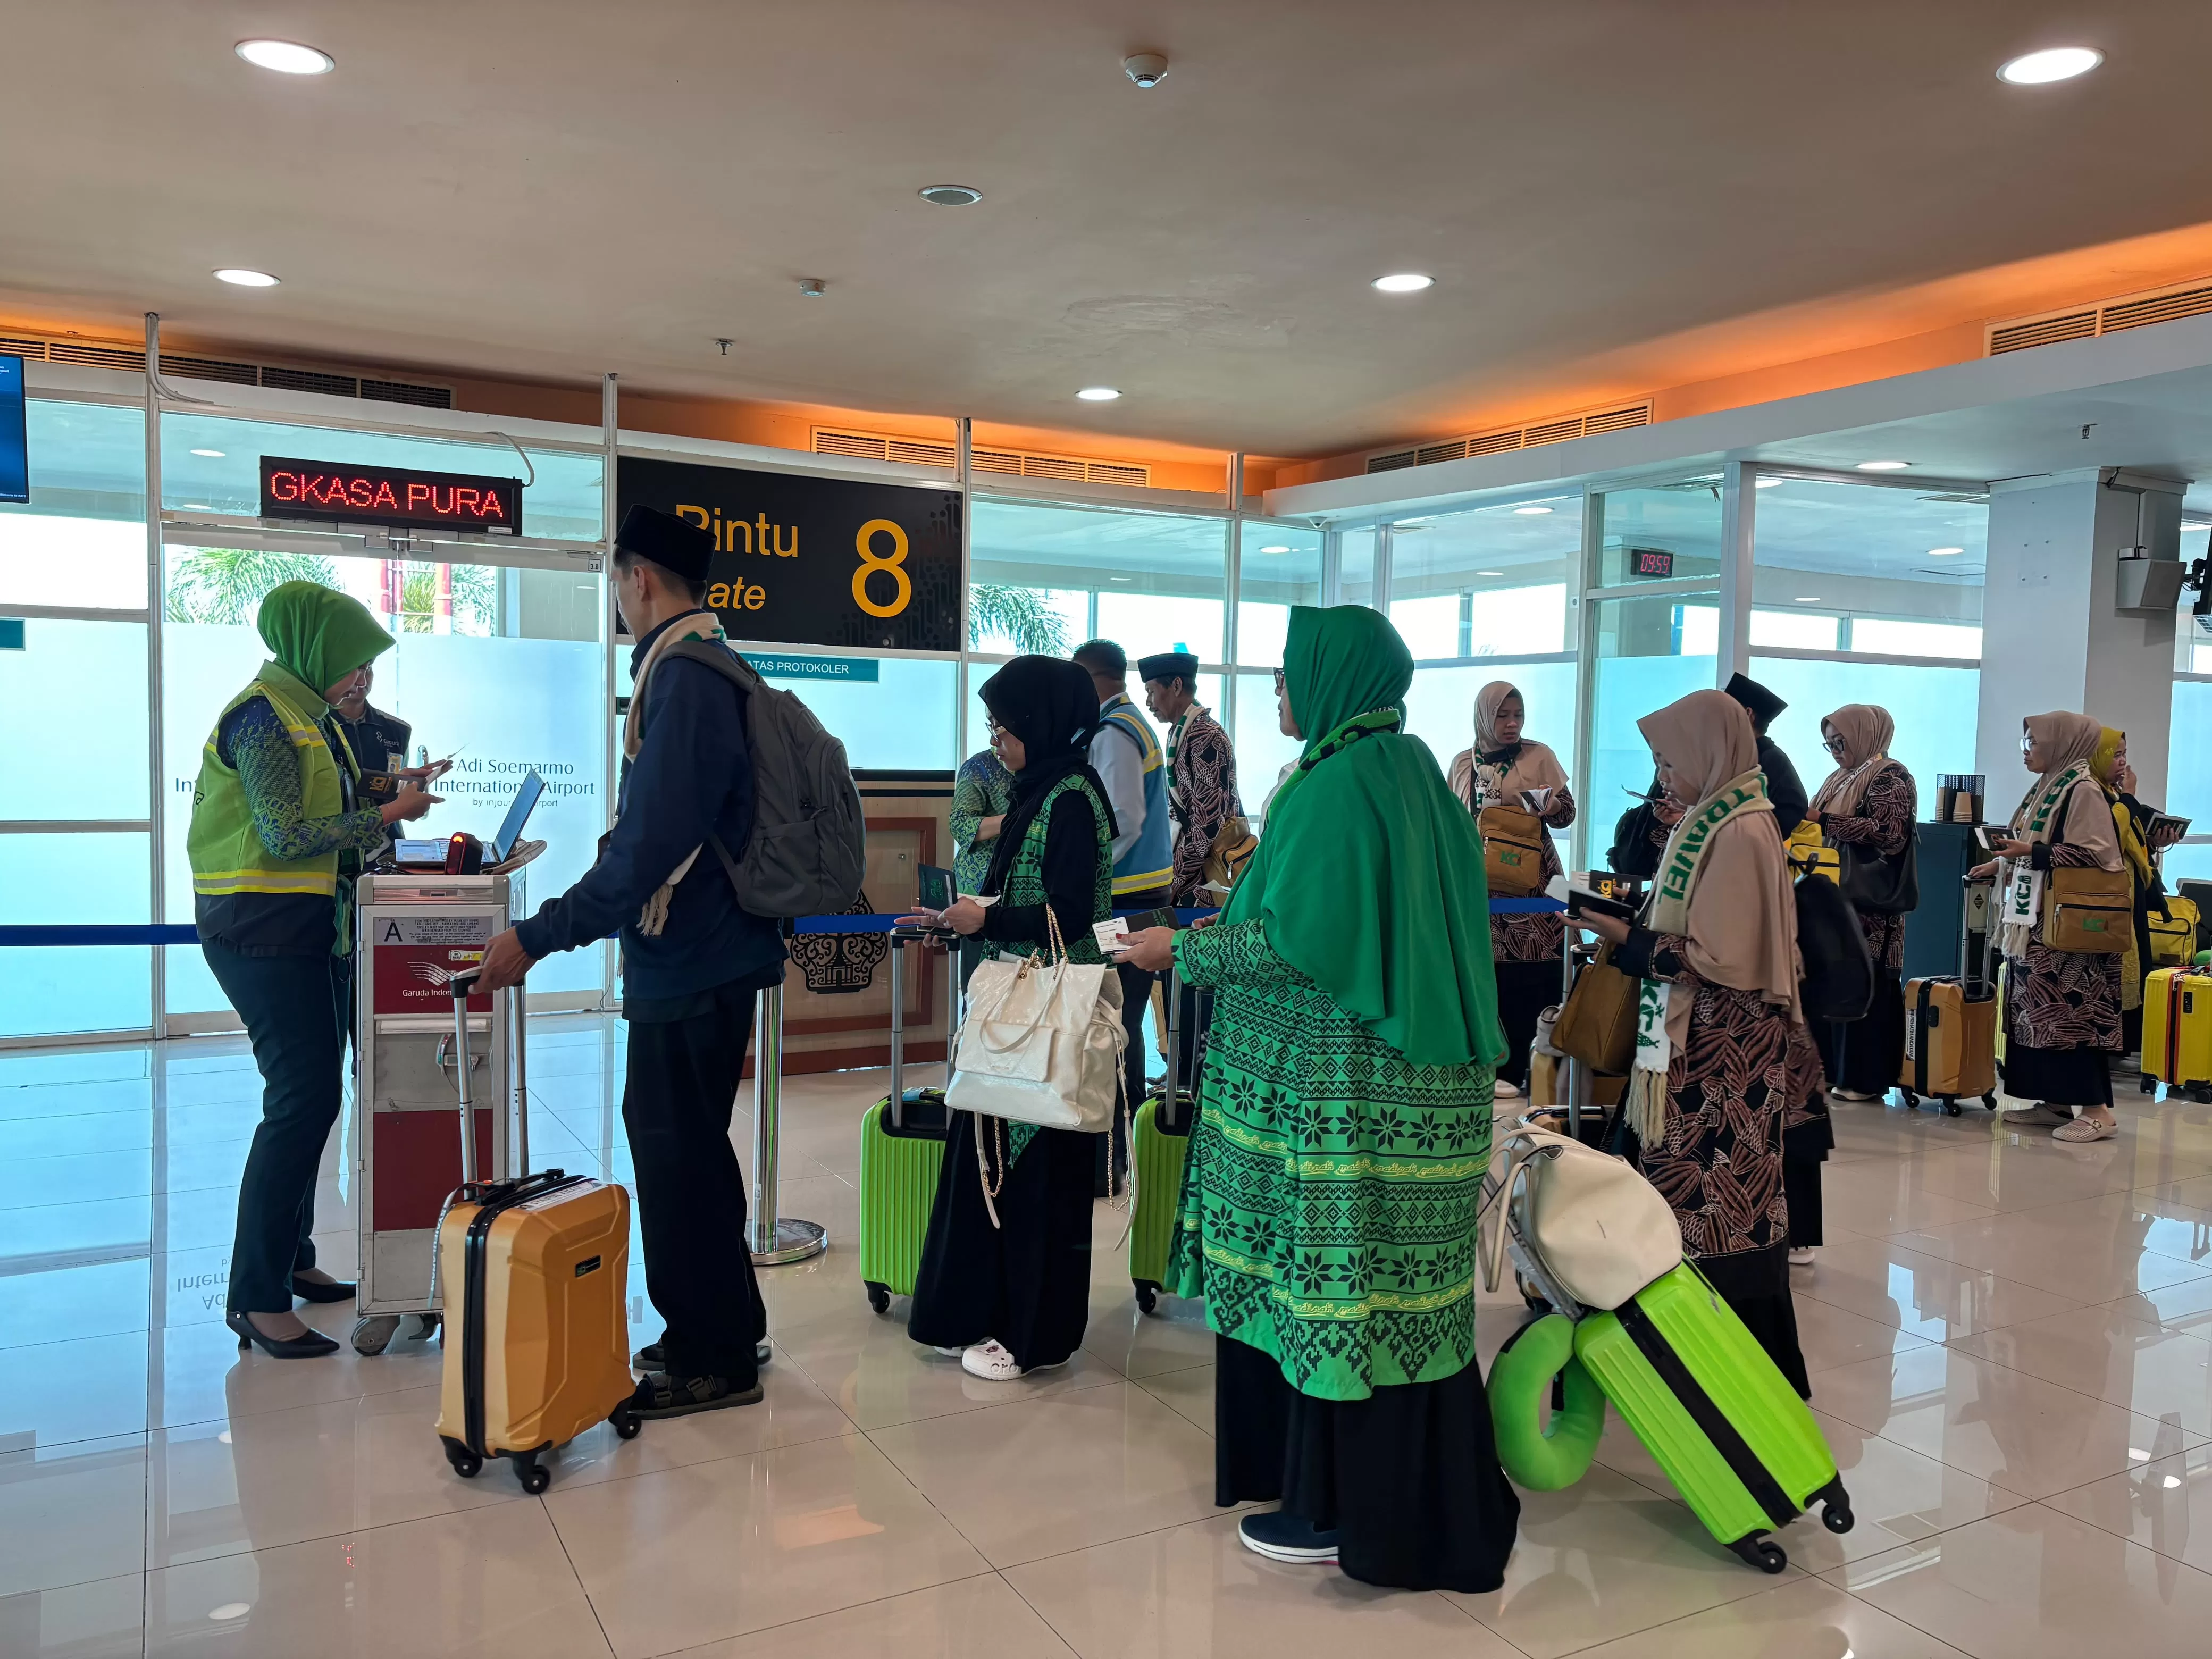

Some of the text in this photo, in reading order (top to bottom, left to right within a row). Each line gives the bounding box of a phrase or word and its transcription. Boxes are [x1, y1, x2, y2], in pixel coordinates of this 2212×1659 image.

[271, 471, 504, 518] GKASA PURA
[852, 518, 912, 618] 8
[1640, 554, 1671, 574] 09:59
[708, 576, 766, 610] ate
[748, 660, 849, 674] ATAS PROTOKOLER
[456, 758, 574, 775] Adi Soemarmo
[434, 779, 595, 797] Internation Airport
[473, 798, 558, 808] by injour irport
[1658, 788, 1756, 904] TRAVEL
[384, 921, 403, 942] A
[990, 1363, 1018, 1375] cro
